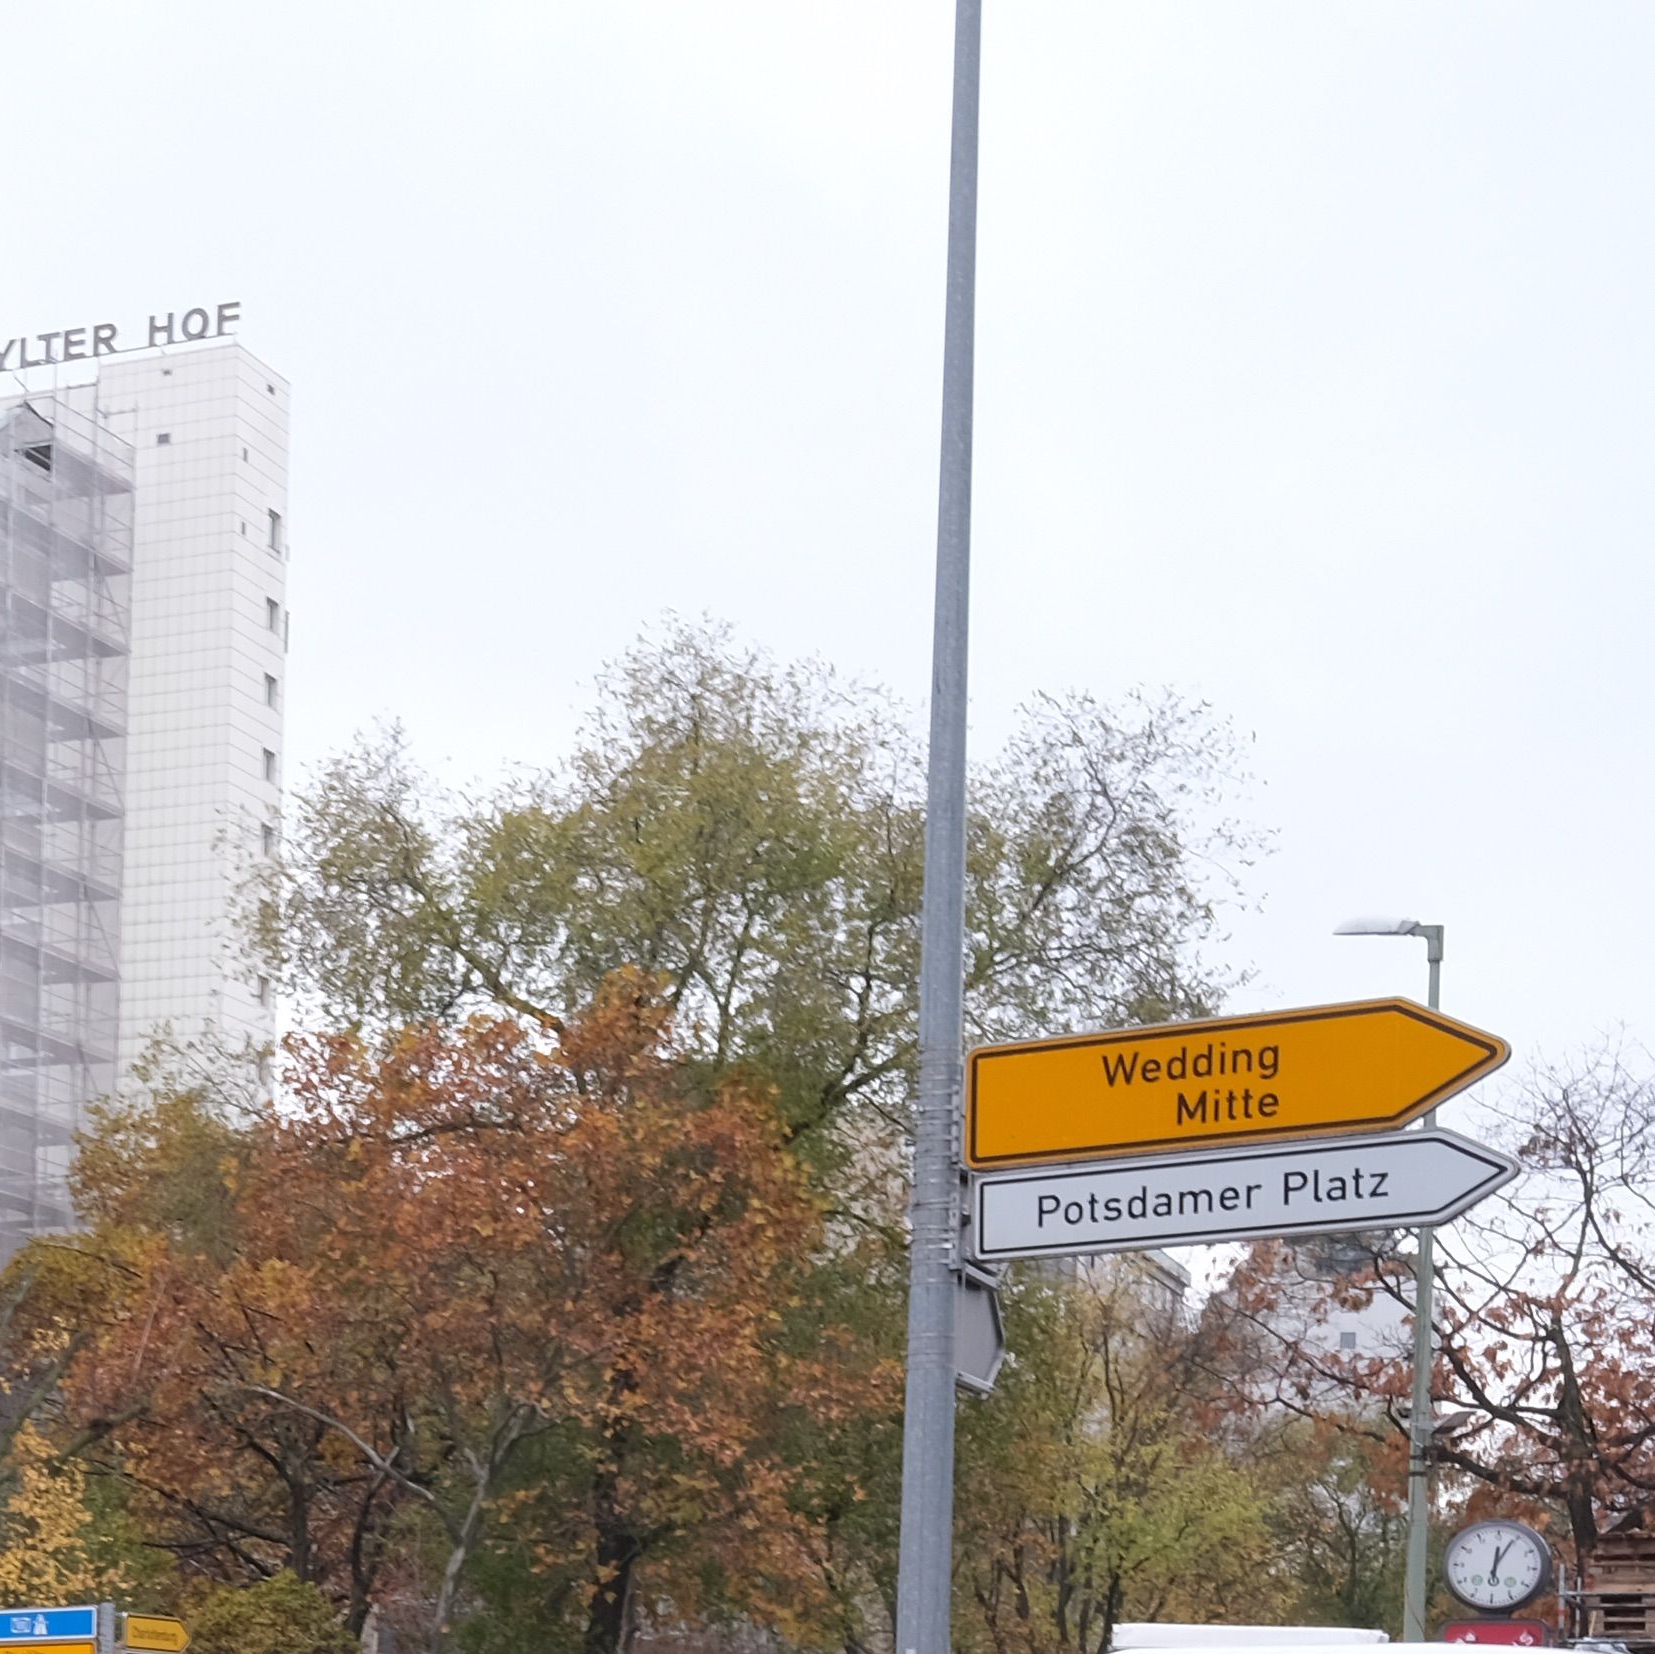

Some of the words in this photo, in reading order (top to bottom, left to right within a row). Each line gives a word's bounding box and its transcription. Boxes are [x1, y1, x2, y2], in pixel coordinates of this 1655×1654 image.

[148, 301, 240, 347] HOF
[1101, 1041, 1280, 1088] Wedding
[1175, 1088, 1280, 1126] Mitte
[1037, 1183, 1262, 1228] Potsdamer
[1282, 1167, 1389, 1206] Platz
